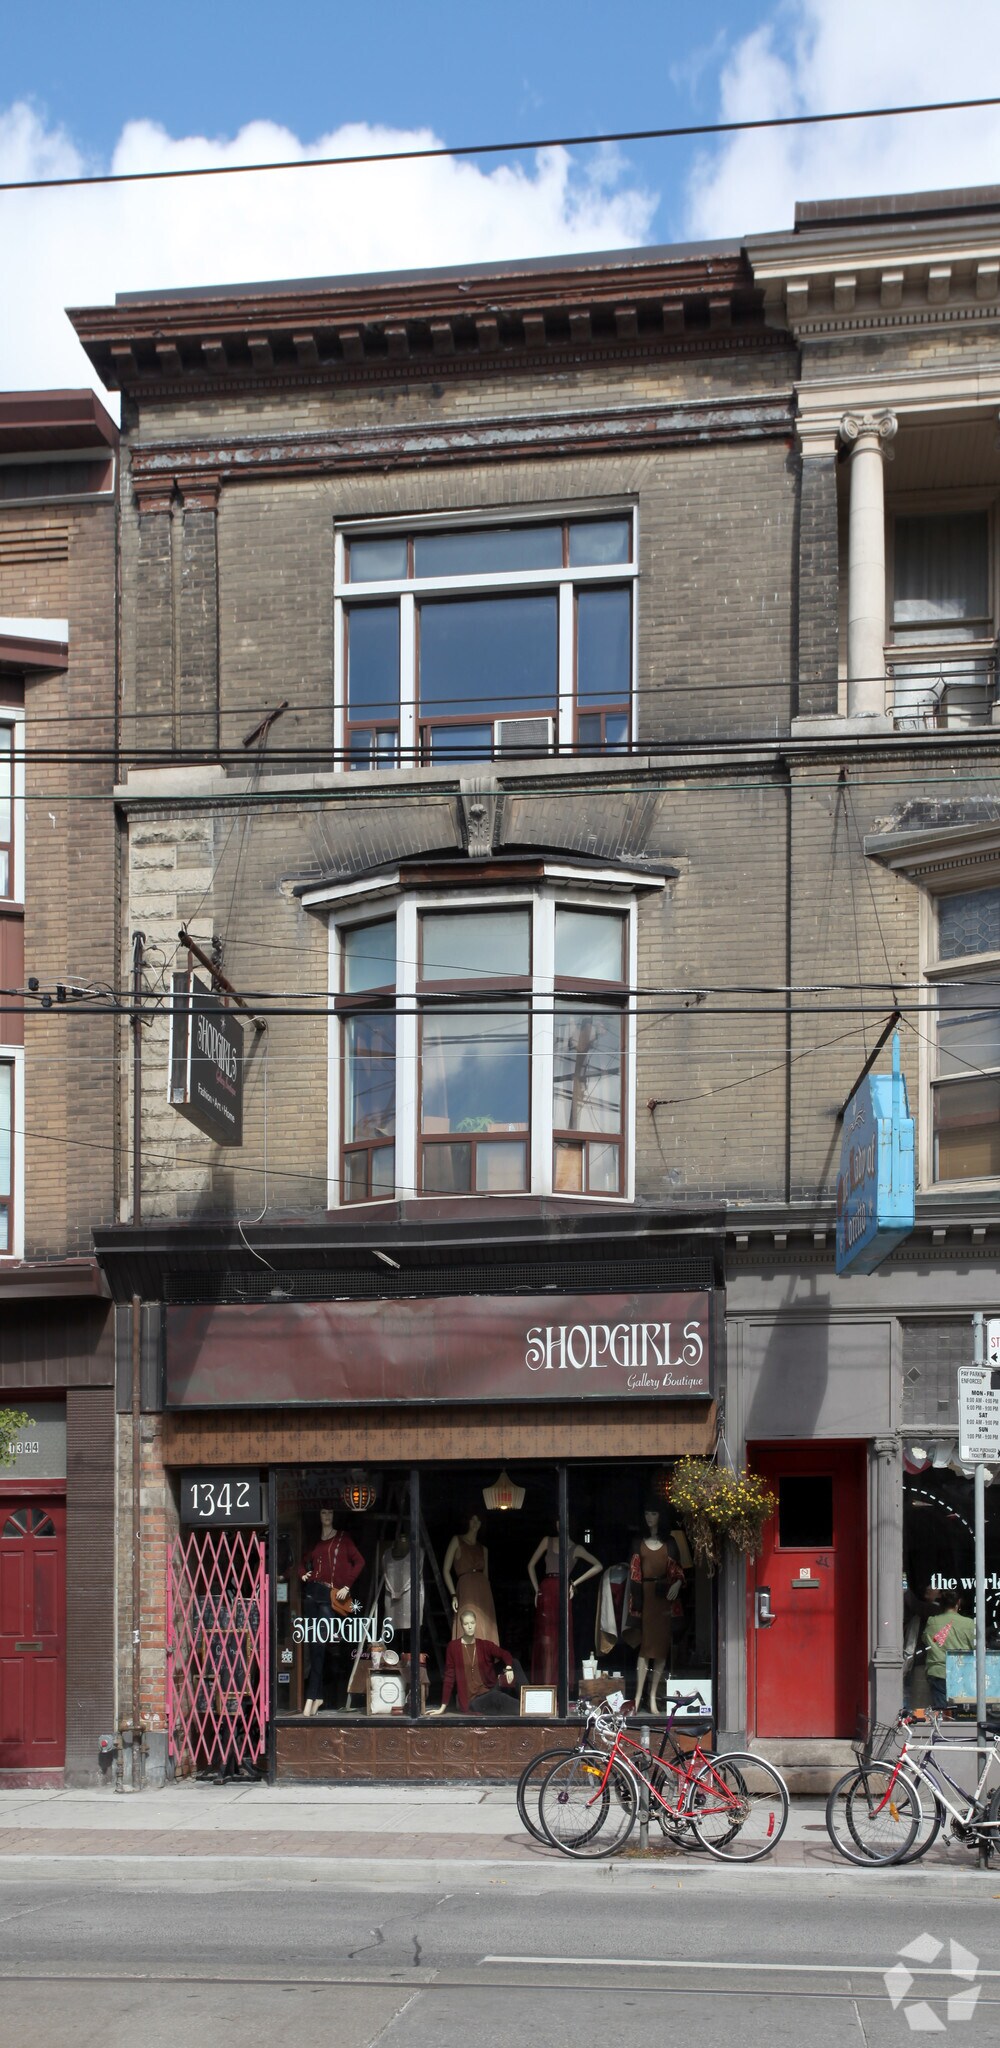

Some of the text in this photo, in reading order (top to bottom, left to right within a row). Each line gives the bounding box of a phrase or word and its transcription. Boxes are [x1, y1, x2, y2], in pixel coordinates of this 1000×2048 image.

[197, 1014, 237, 1082] SHOPGIRLS
[224, 1104, 235, 1123] Home
[525, 1321, 703, 1371] SHOPGIRLS
[627, 1372, 703, 1391] Gallery Boutique
[9, 1442, 39, 1453] 1344
[190, 1482, 251, 1517] 1342
[930, 1573, 958, 1590] the
[292, 1616, 395, 1644] SHOPGIRLS
